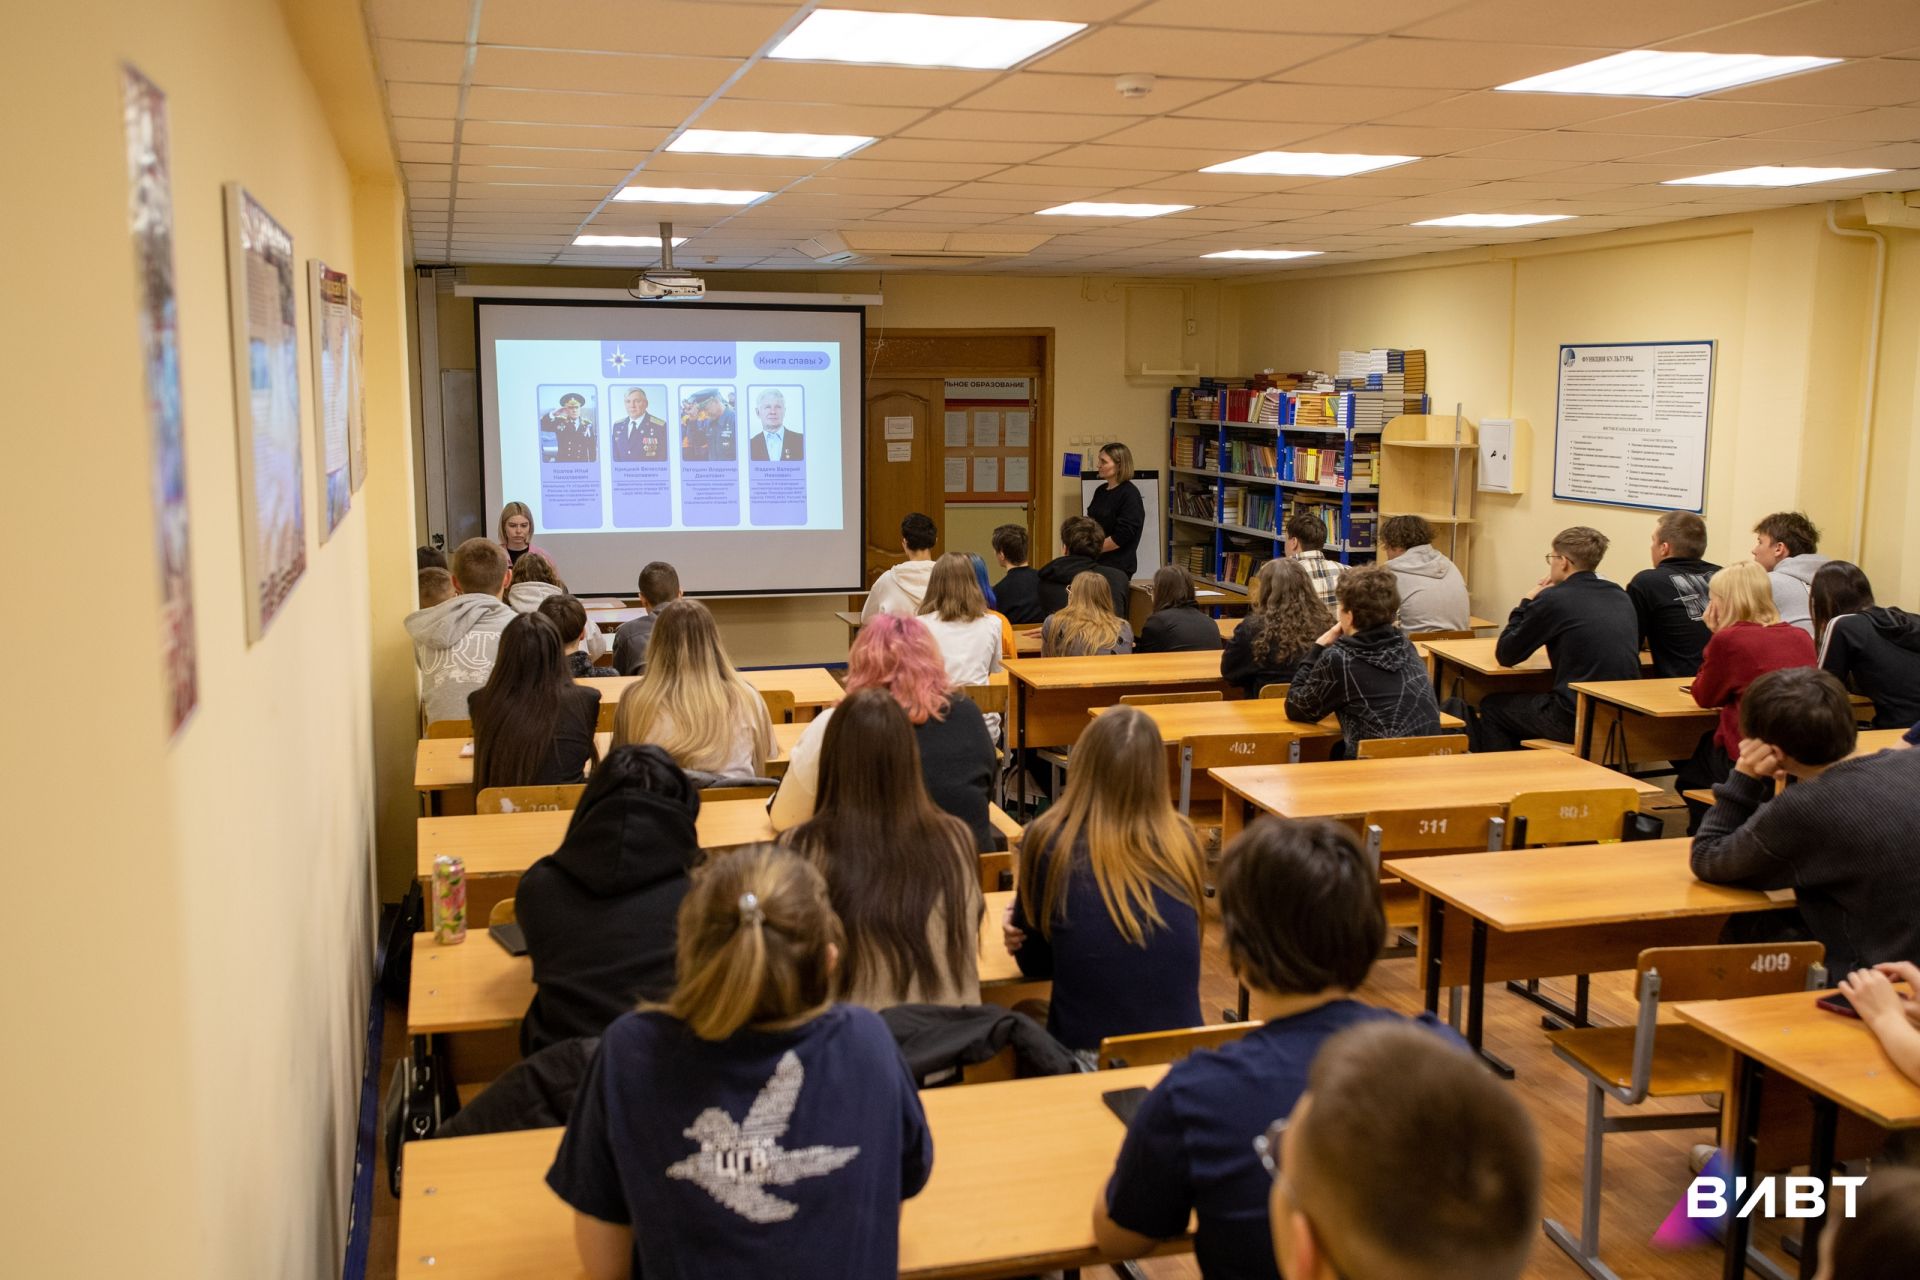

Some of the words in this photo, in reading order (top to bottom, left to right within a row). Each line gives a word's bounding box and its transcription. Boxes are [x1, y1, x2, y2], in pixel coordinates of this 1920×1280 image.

[635, 355, 677, 365] ГЕРОИ
[680, 355, 732, 365] РОССИИ
[759, 357, 787, 366] Книга
[788, 358, 816, 366] славы
[1229, 741, 1257, 755] 402
[1418, 818, 1449, 835] 311
[1750, 952, 1792, 973] 409
